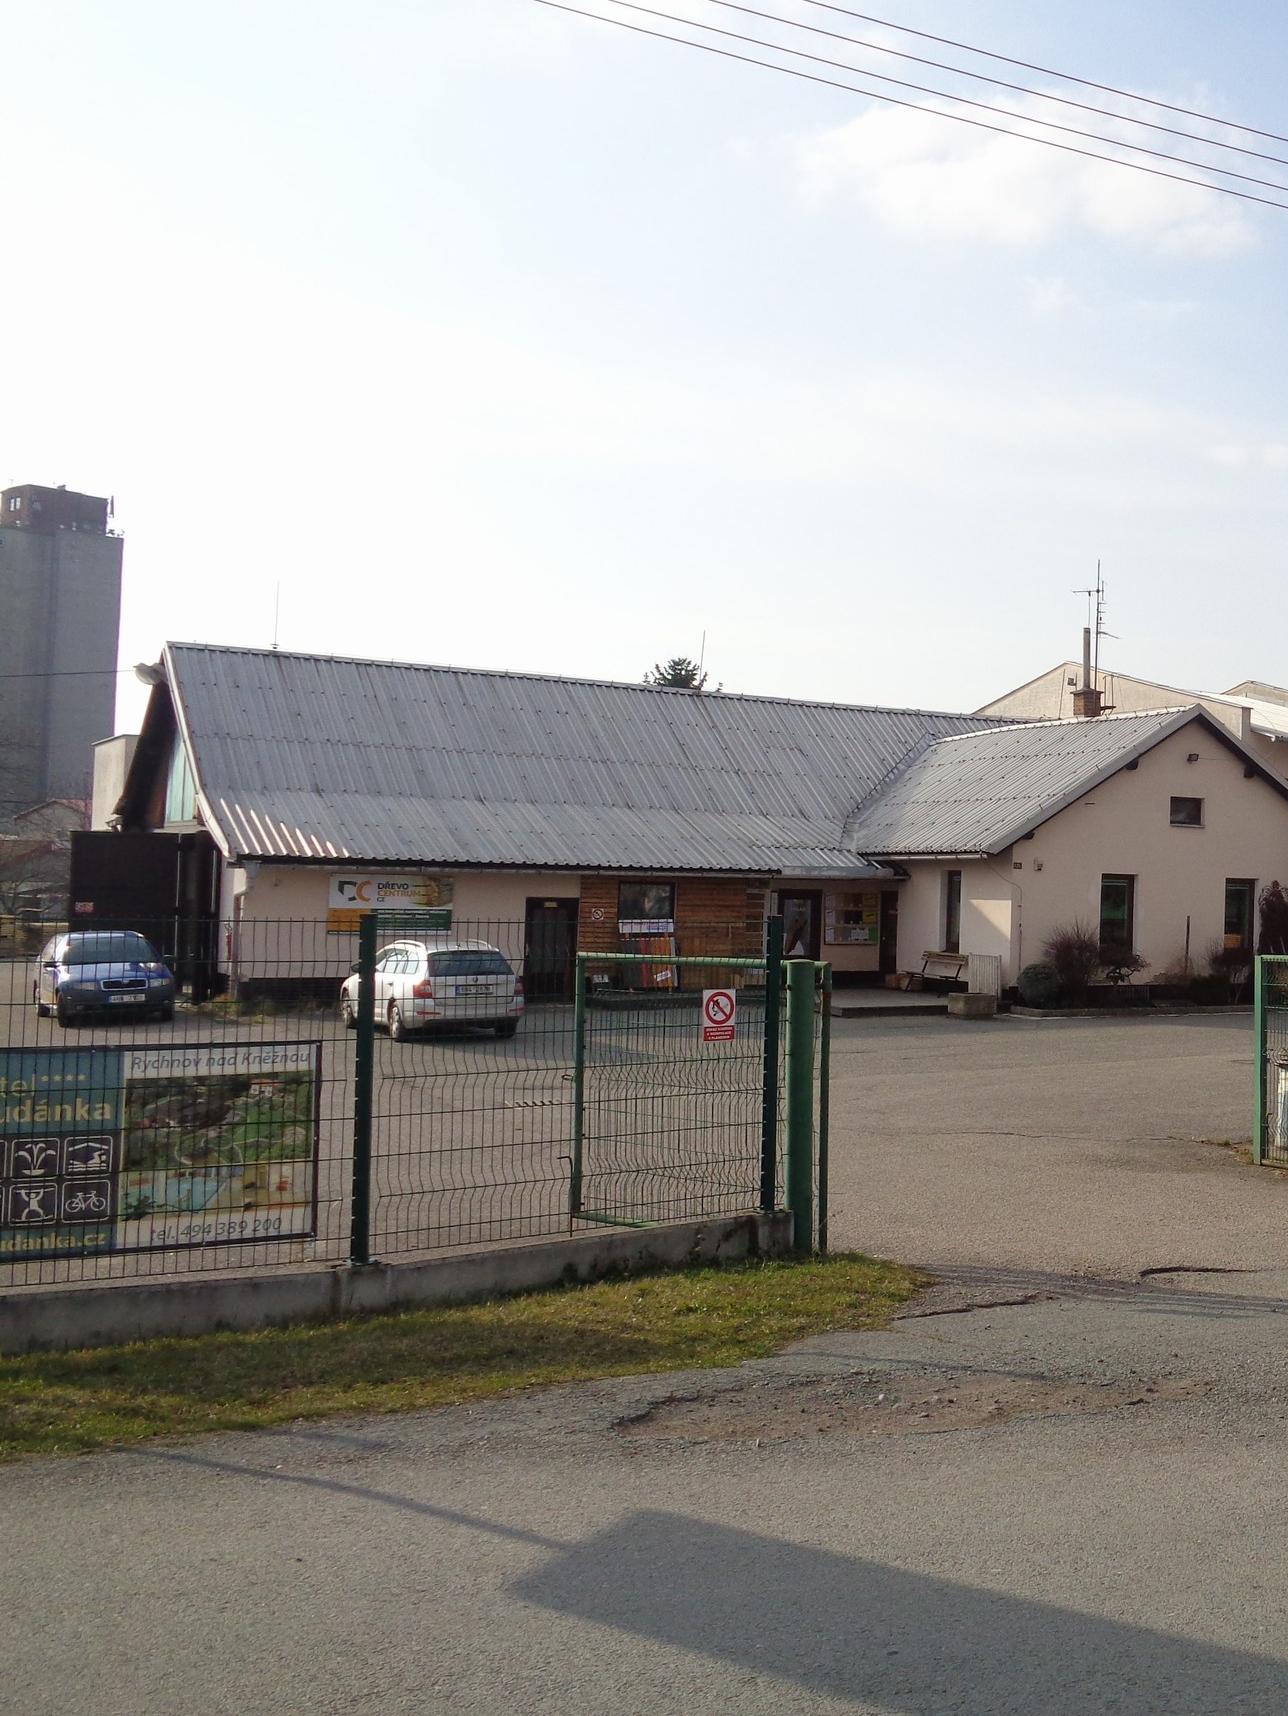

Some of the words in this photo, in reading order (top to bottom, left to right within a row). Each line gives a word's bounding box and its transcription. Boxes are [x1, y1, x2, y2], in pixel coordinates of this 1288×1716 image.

[132, 1055, 202, 1073] Rychnov
[205, 1053, 237, 1067] nad
[241, 1051, 310, 1065] Kněžnou
[180, 1223, 212, 1238] 494
[253, 1217, 282, 1232] 200
